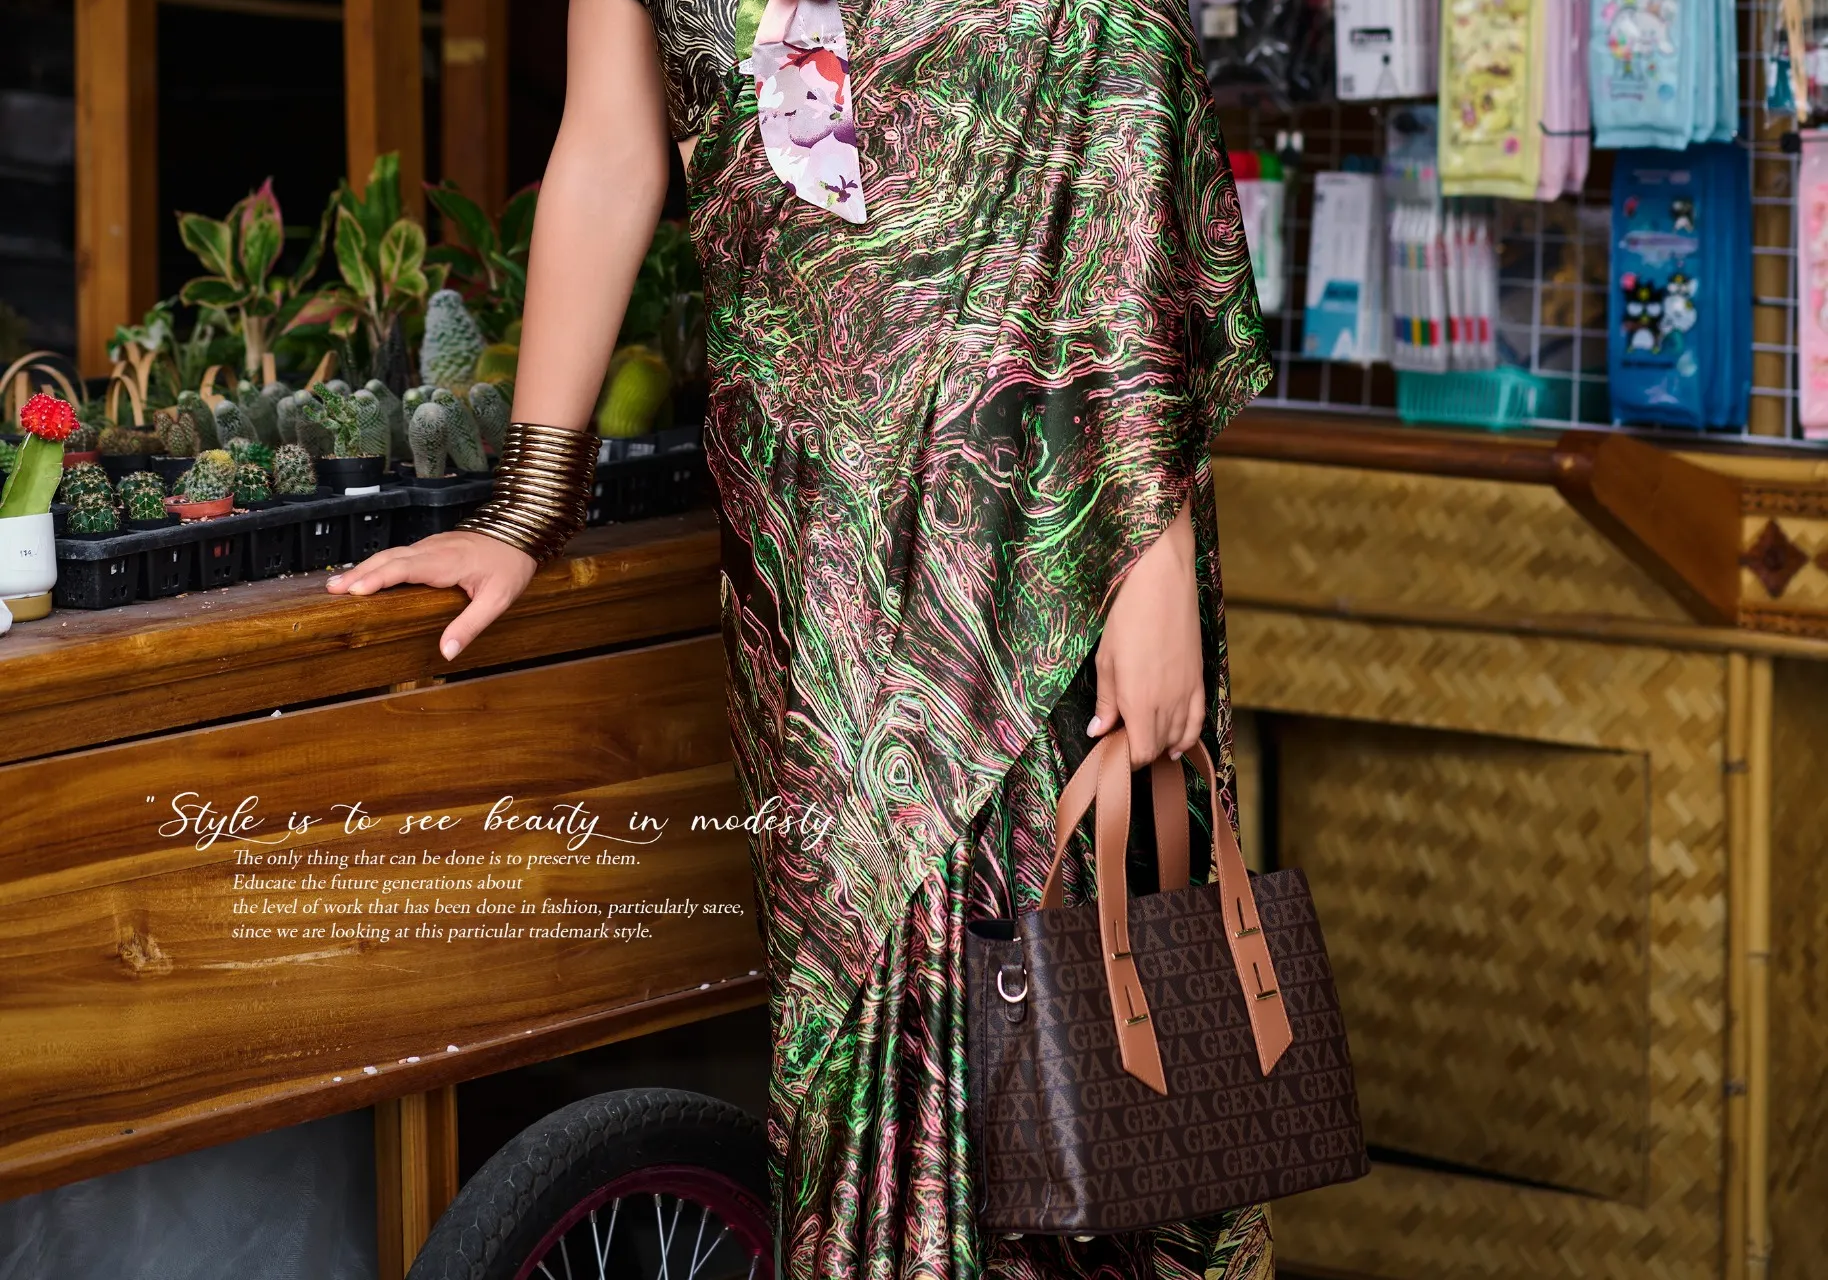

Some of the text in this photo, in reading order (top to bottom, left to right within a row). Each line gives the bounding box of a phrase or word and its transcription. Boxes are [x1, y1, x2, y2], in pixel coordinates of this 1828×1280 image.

[1157, 998, 1245, 1037] GEXYA
[1171, 1055, 1257, 1095] GEXYA
[1123, 1093, 1208, 1134] GEXYA
[1212, 1077, 1297, 1118] GEXYA
[1091, 1130, 1180, 1172] GEXYA
[1183, 1113, 1268, 1154] GEXYA
[1271, 1098, 1350, 1138] GEXYA
[1132, 1153, 1219, 1195] GEXYA
[1222, 1136, 1307, 1177] GEXYA
